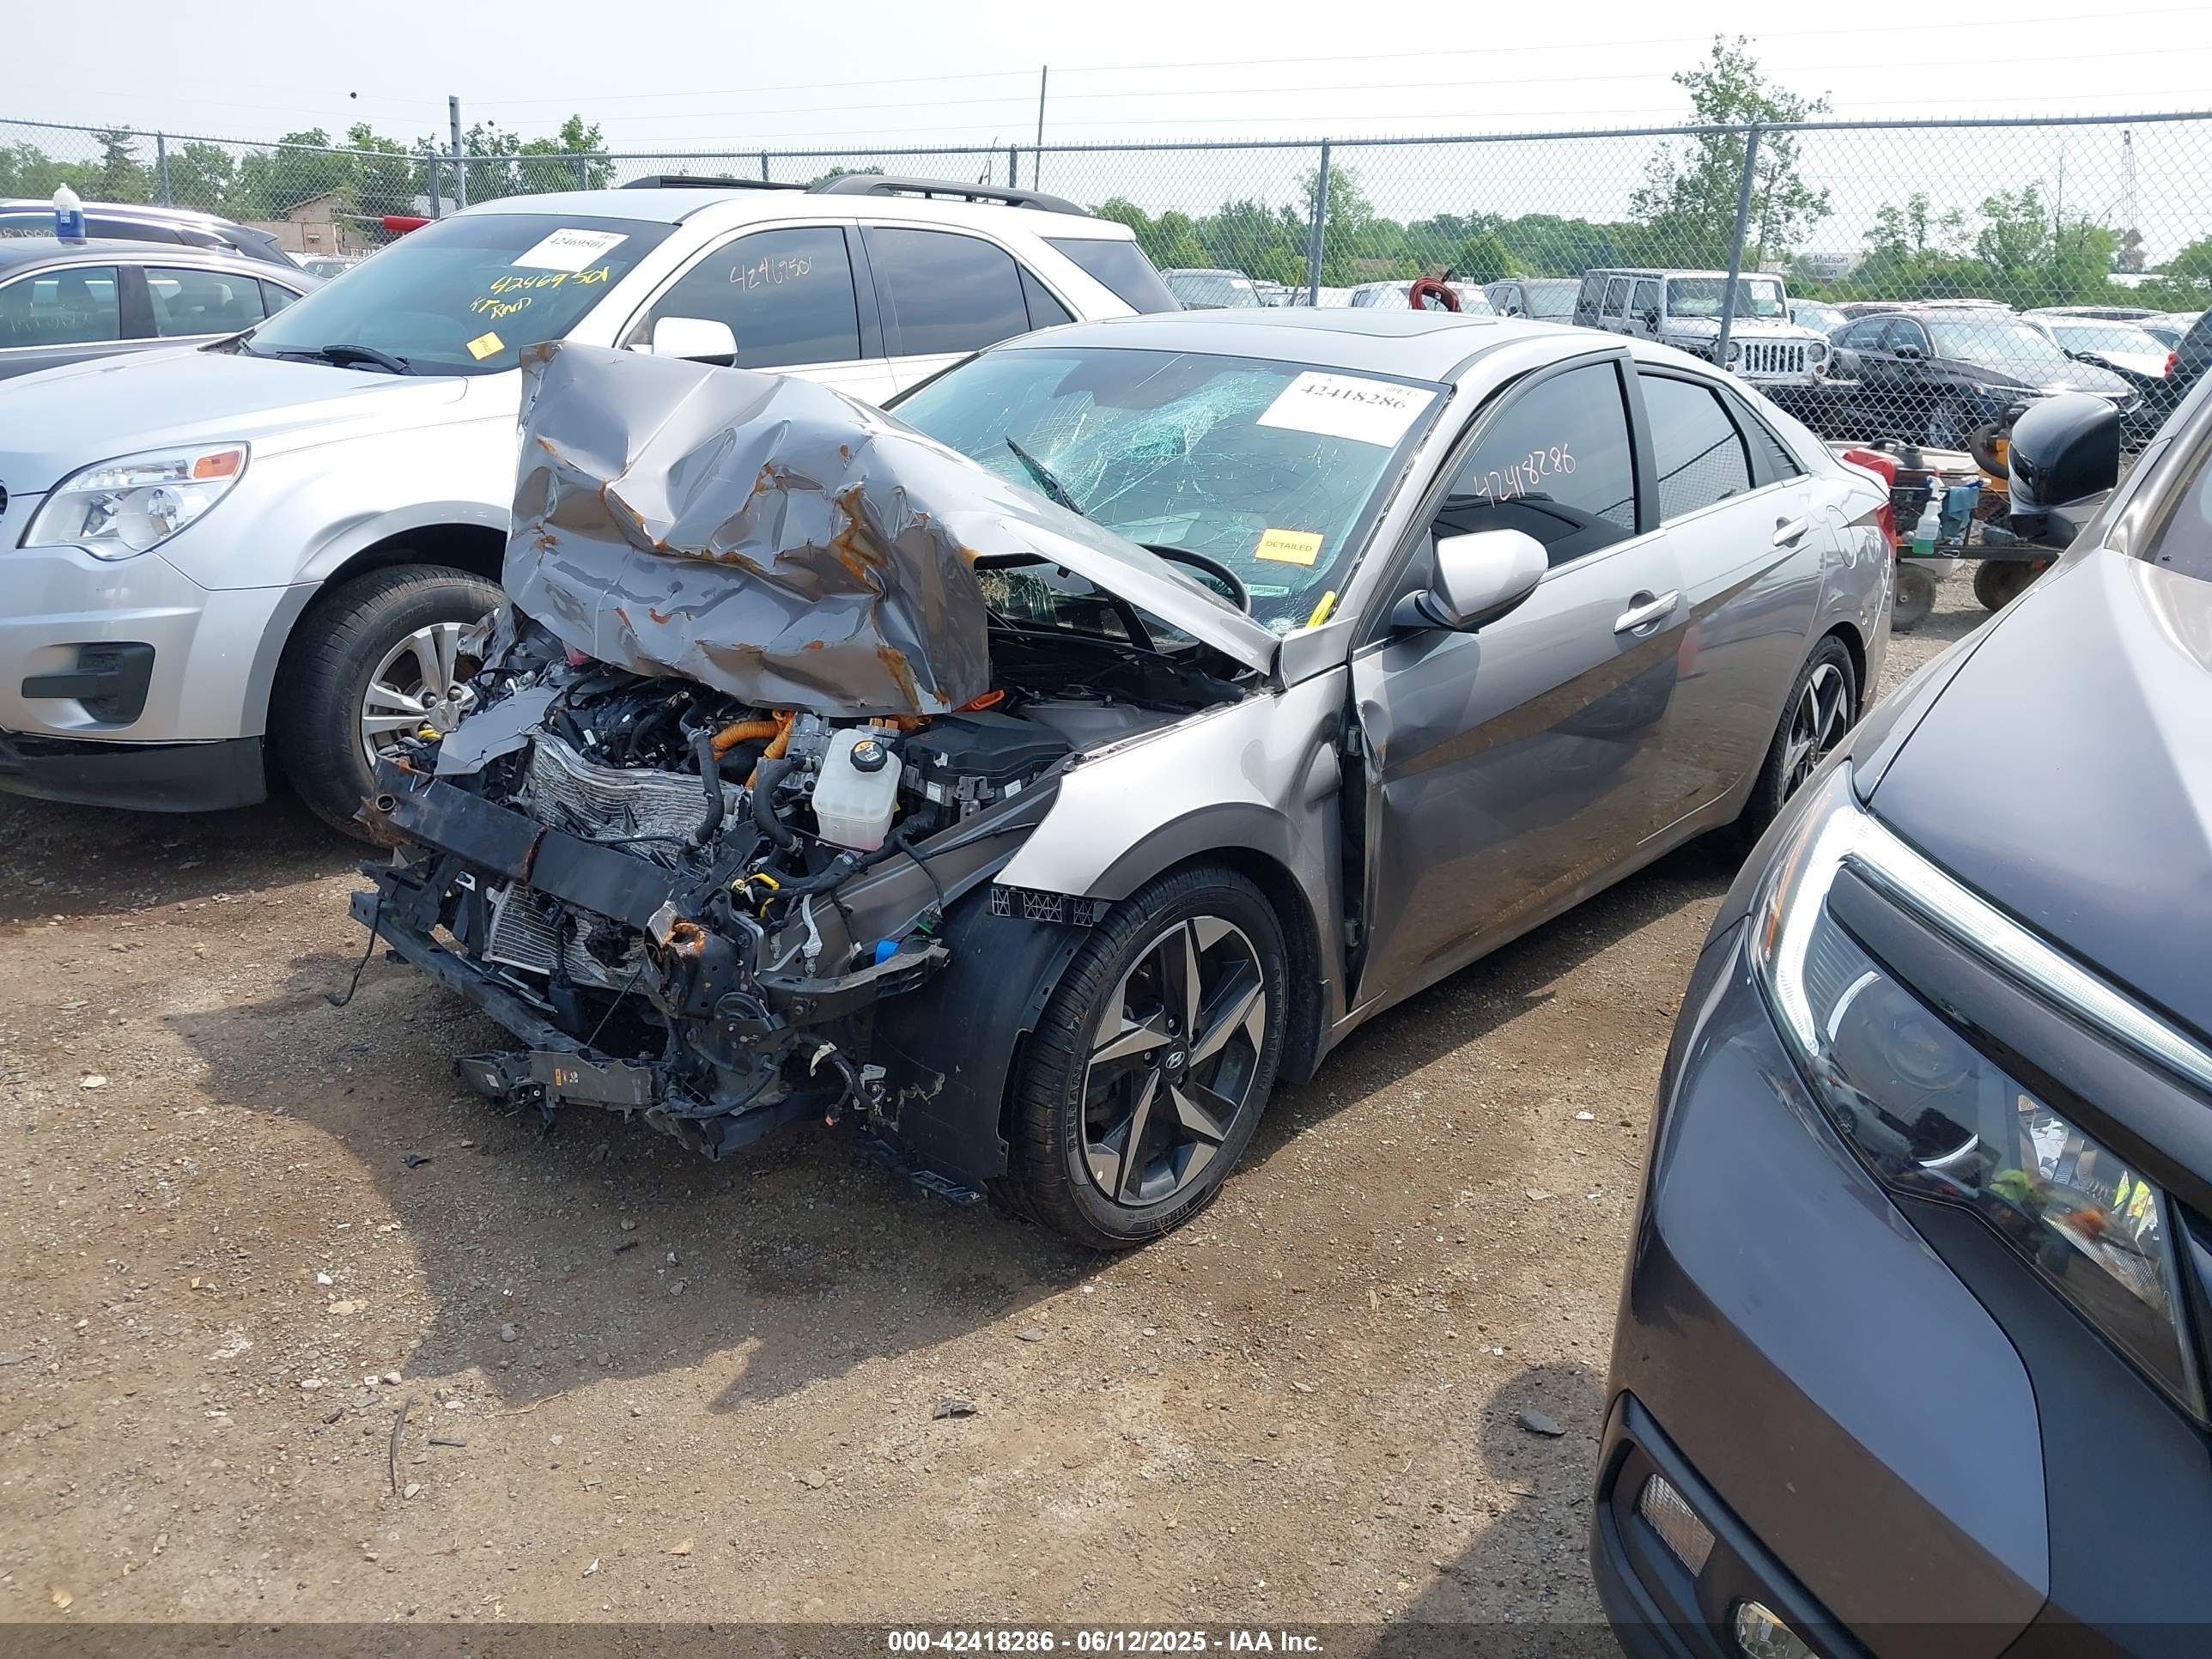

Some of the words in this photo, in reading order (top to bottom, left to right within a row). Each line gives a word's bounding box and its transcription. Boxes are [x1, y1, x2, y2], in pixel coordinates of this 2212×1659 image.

[550, 236, 607, 249] 42469501
[729, 255, 812, 293] 42469501
[1300, 384, 1406, 409] 42418286
[1474, 441, 1577, 509] 42418286
[1266, 540, 1313, 552] DETAILED
